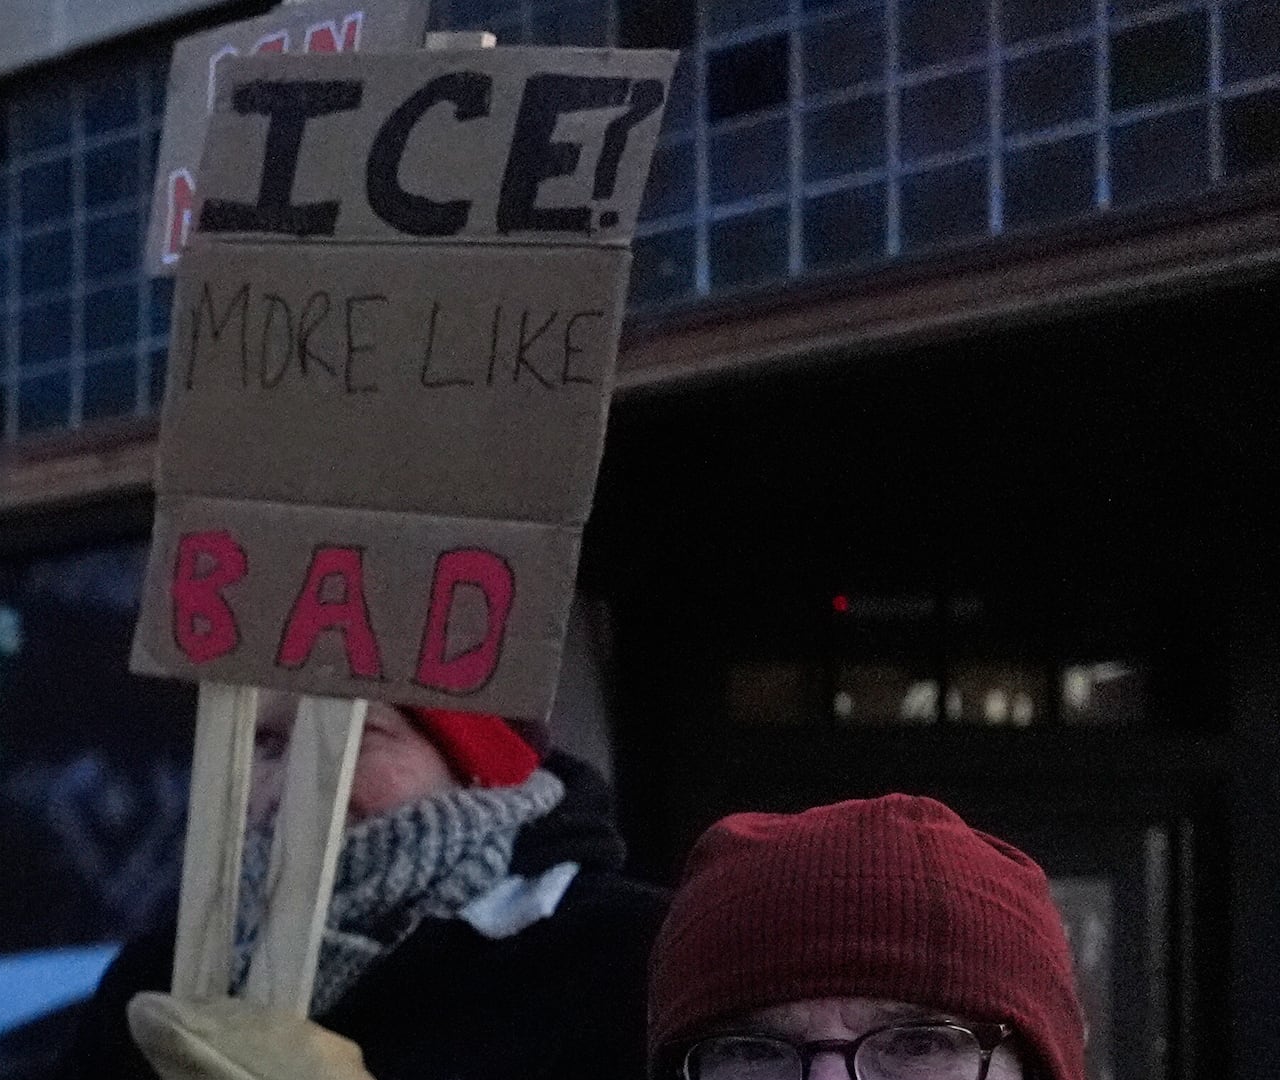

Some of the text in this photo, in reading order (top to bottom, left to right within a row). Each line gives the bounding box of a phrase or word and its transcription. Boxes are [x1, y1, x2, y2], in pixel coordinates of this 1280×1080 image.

[198, 70, 667, 237] ICE?
[184, 282, 607, 395] MORE LIKE
[171, 529, 517, 695] BAD
